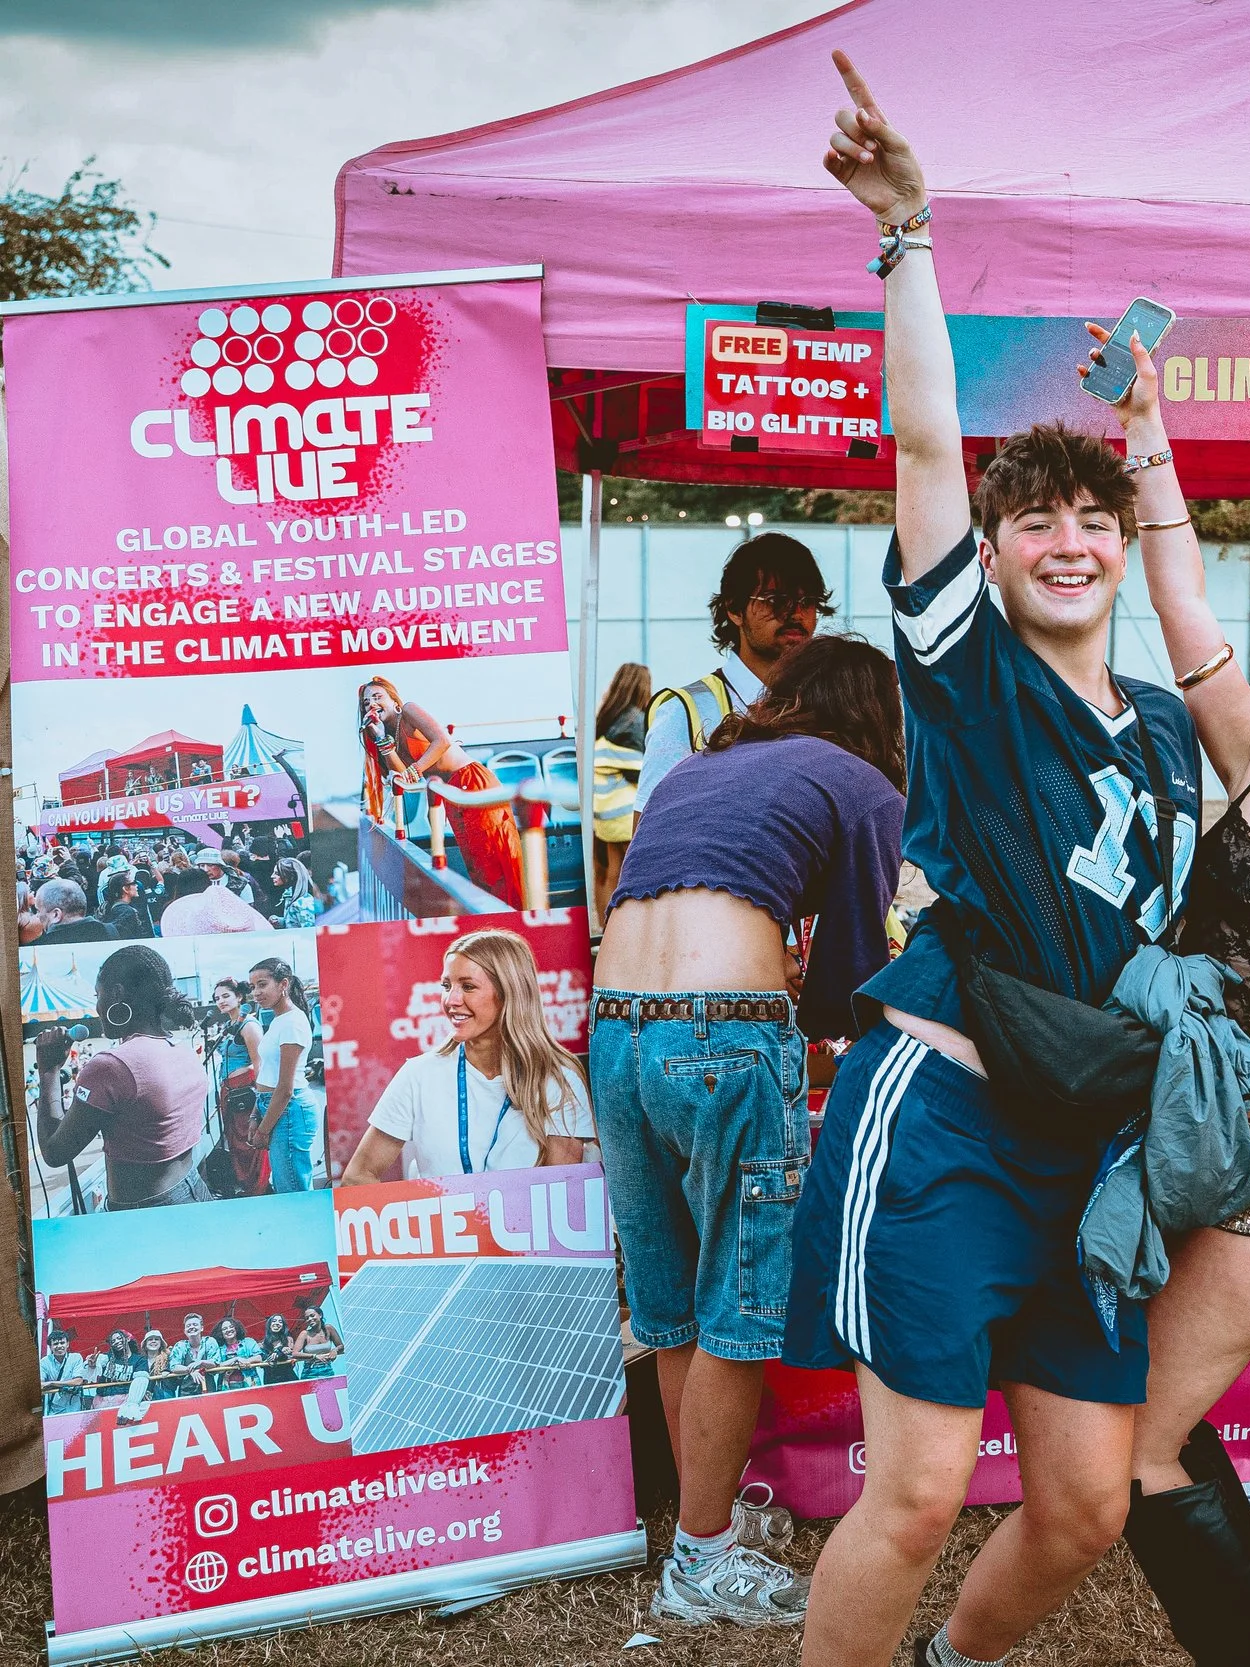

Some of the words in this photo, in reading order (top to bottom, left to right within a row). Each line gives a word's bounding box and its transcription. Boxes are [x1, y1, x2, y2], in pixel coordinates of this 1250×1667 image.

[719, 336, 782, 356] FREE
[793, 340, 872, 363] TEMP
[717, 373, 848, 400] TATTOOS
[854, 383, 869, 399] +
[130, 393, 433, 459] CLIMATE
[707, 411, 755, 431] BIO
[761, 414, 878, 438] GLITTER
[116, 523, 257, 553] GLOBAL
[266, 509, 467, 545] YOUTH-LED
[15, 561, 209, 594] CONCERTS
[219, 560, 242, 586] &
[252, 551, 414, 584] FESTIVAL
[423, 540, 558, 572] STAGES
[30, 603, 81, 630] TO
[93, 595, 240, 627] ENGAGE
[251, 594, 273, 621] A
[284, 589, 363, 620] NEW
[372, 579, 545, 615] AUDIENCE
[41, 643, 80, 667] IN
[91, 637, 165, 667] THE
[175, 631, 330, 662] CLIMATE
[341, 617, 539, 654] MOVEMENT
[48, 812, 71, 827] CAN
[74, 809, 100, 826] YOU
[104, 799, 150, 822] HEAR
[155, 793, 184, 814] US
[189, 784, 261, 811] YET?
[488, 1177, 606, 1252] LIV
[46, 1402, 283, 1498] HEAR
[250, 1460, 491, 1521] climateliveuk
[238, 1509, 503, 1581] climatelive.org
